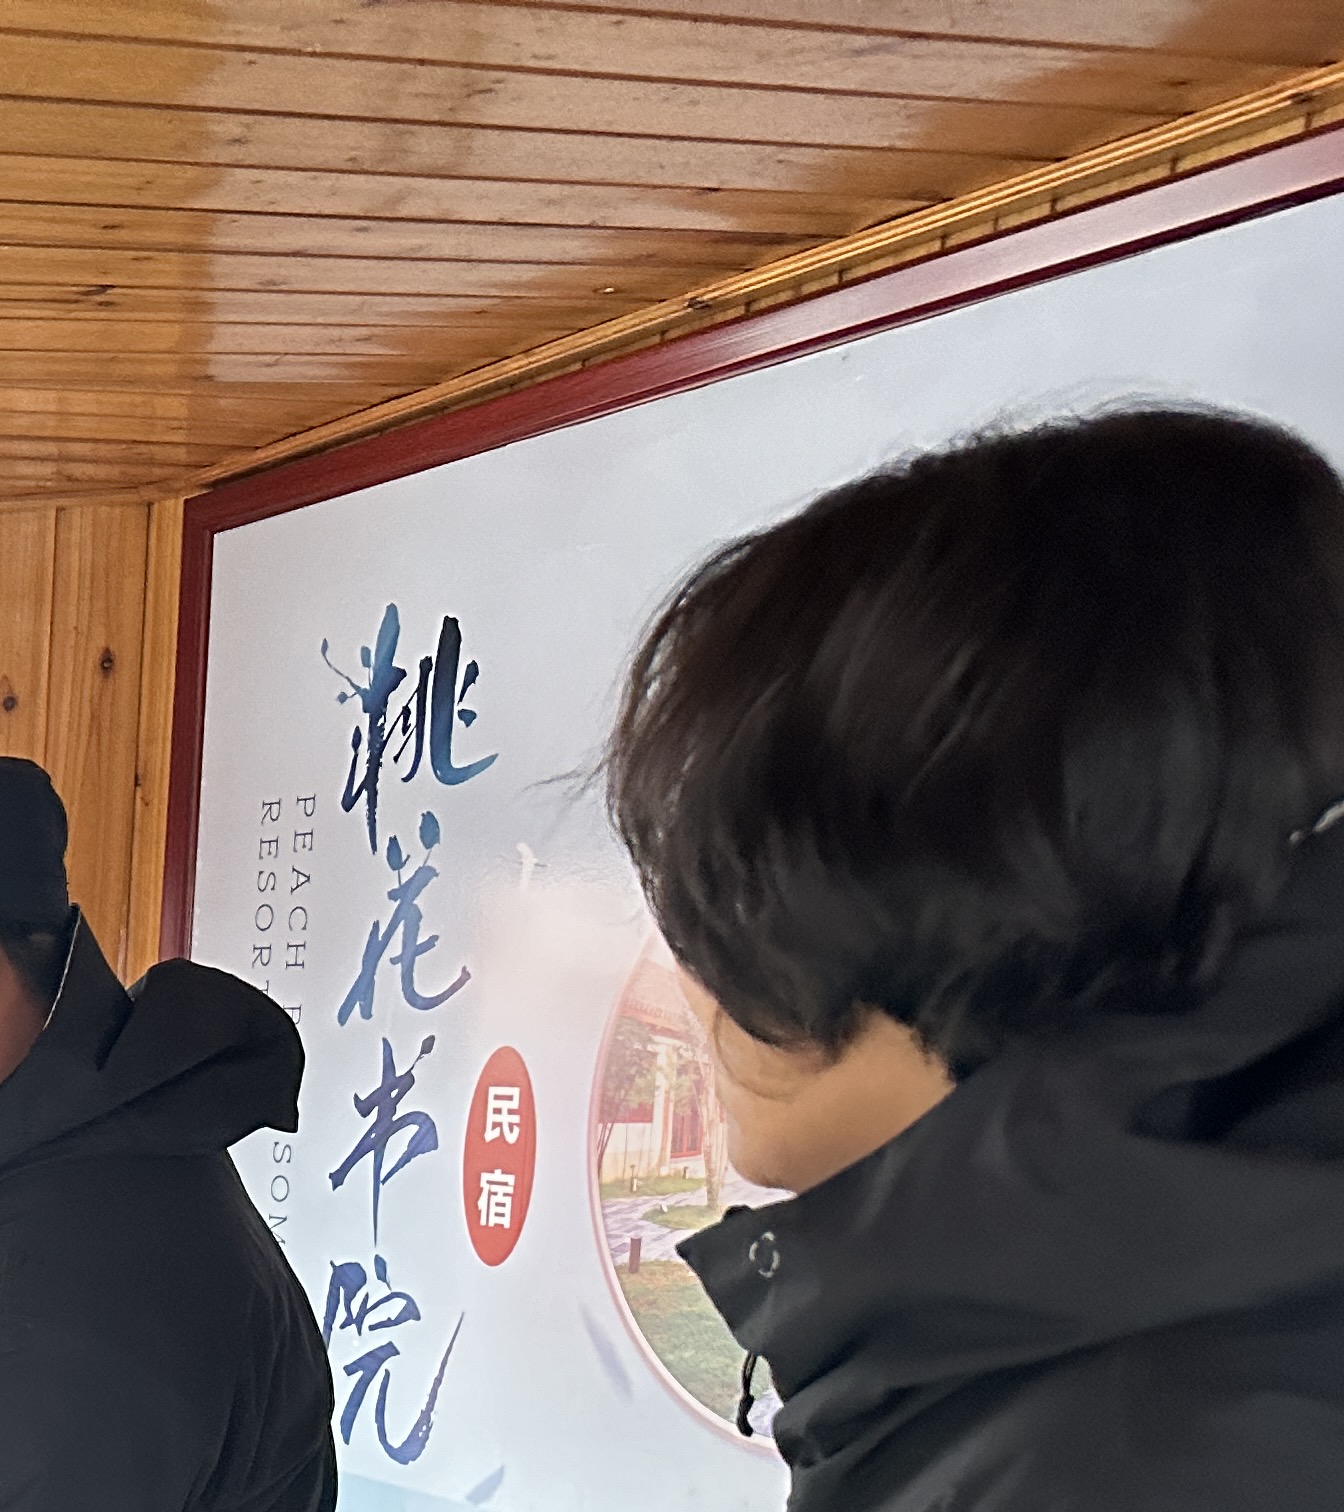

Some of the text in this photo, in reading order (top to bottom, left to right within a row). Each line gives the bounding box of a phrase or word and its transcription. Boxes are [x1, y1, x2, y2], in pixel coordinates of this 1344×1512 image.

[284, 794, 317, 971] PEACH
[321, 602, 499, 1464] 桃花书院
[477, 1083, 522, 1231] 民宿
